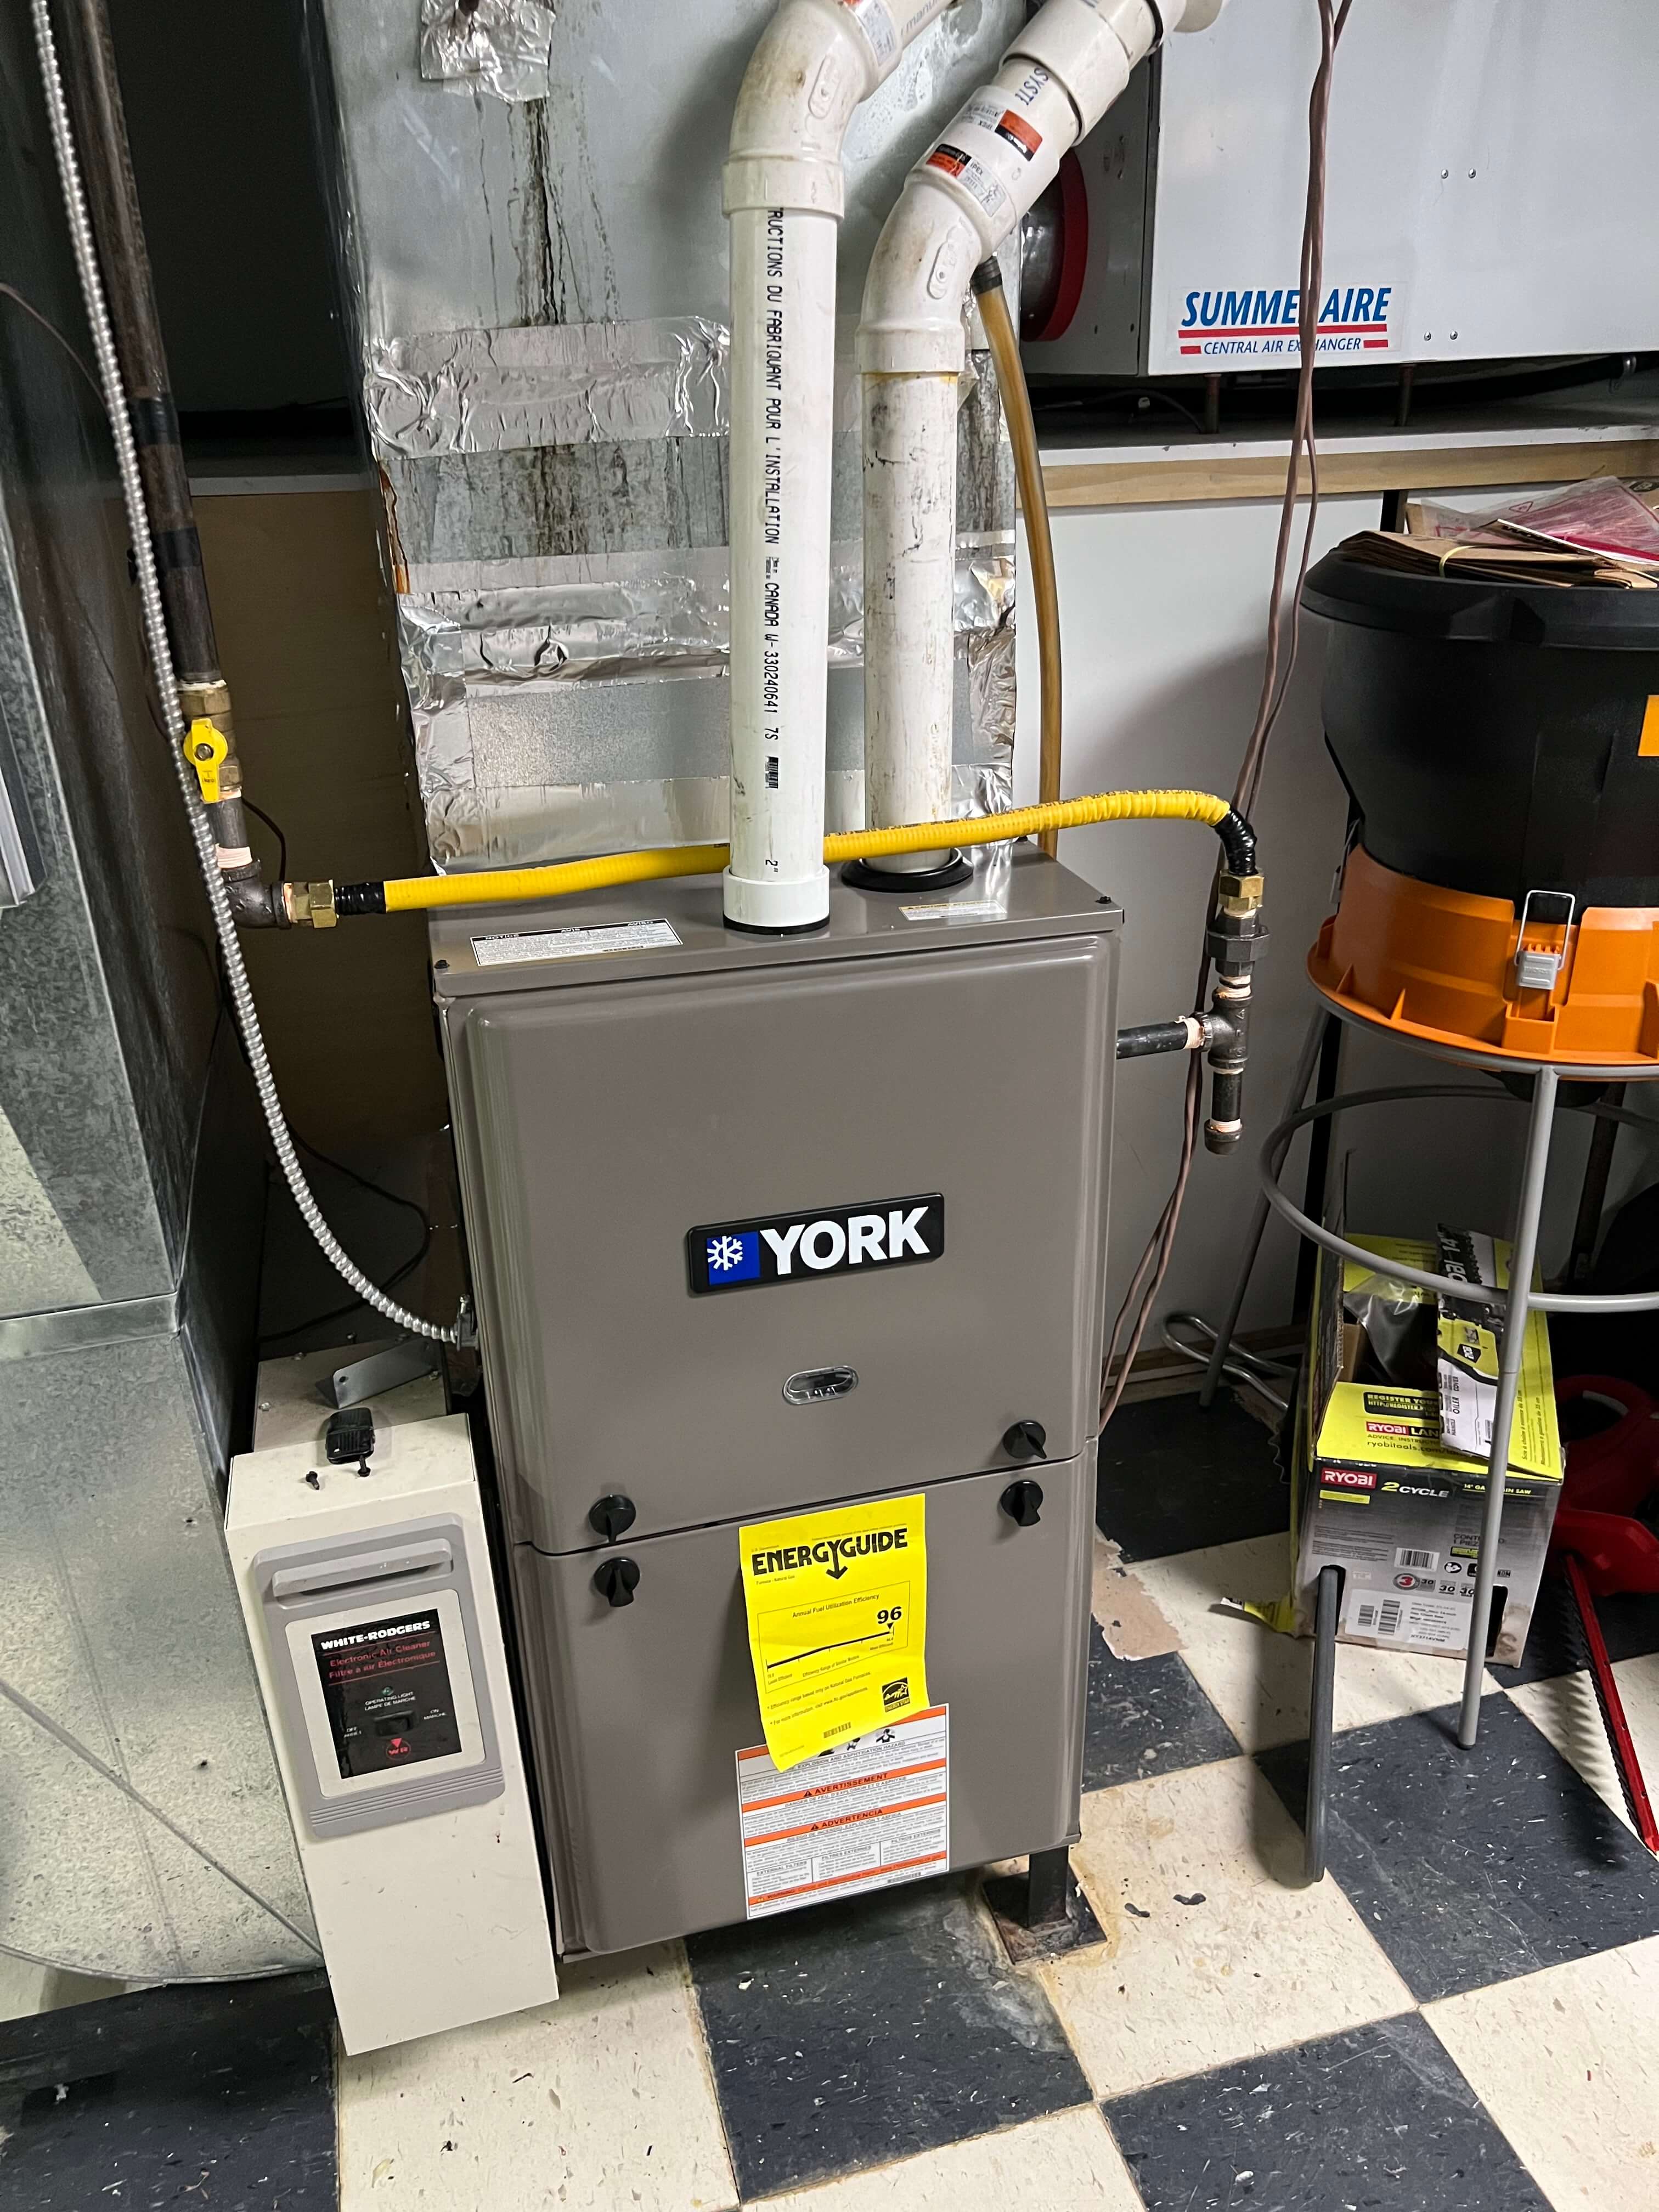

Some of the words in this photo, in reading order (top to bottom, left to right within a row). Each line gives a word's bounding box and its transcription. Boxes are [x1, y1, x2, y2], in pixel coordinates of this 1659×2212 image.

[767, 285, 782, 302] DU
[1181, 289, 1392, 326] SUMMEAIRE
[766, 309, 782, 390] FABRIQUANT
[1204, 341, 1258, 354] CENTRAL
[1262, 340, 1283, 353] AIR
[1288, 337, 1361, 352] EXANGER
[766, 398, 782, 430] POUR
[765, 583, 780, 627] CANADA
[760, 1206, 930, 1276] YORK
[1367, 1394, 1411, 1403] REGISTER
[1368, 1423, 1406, 1434] RYOBI
[1324, 1471, 1373, 1486] RYOBI
[752, 1528, 908, 1576] ENERGYGUIDE
[1399, 1576, 1413, 1586] 3
[792, 1609, 811, 1618] Annual
[826, 1600, 853, 1610] Utilization
[854, 1593, 879, 1604] Efficiency
[877, 1606, 902, 1624] 96
[321, 1621, 431, 1650] WHITE-RODGERS
[330, 1652, 377, 1667] Electronic
[380, 1648, 392, 1656] Air
[395, 1641, 431, 1654] Cleaner
[329, 1667, 353, 1679] Filtre
[365, 1695, 397, 1706] OPERATING
[798, 1758, 830, 1769] EXPLOSION
[815, 1773, 888, 1795] AVERTISSEMENT
[785, 1798, 809, 1808] DANGER
[822, 1809, 883, 1827] ADVERTENCIA
